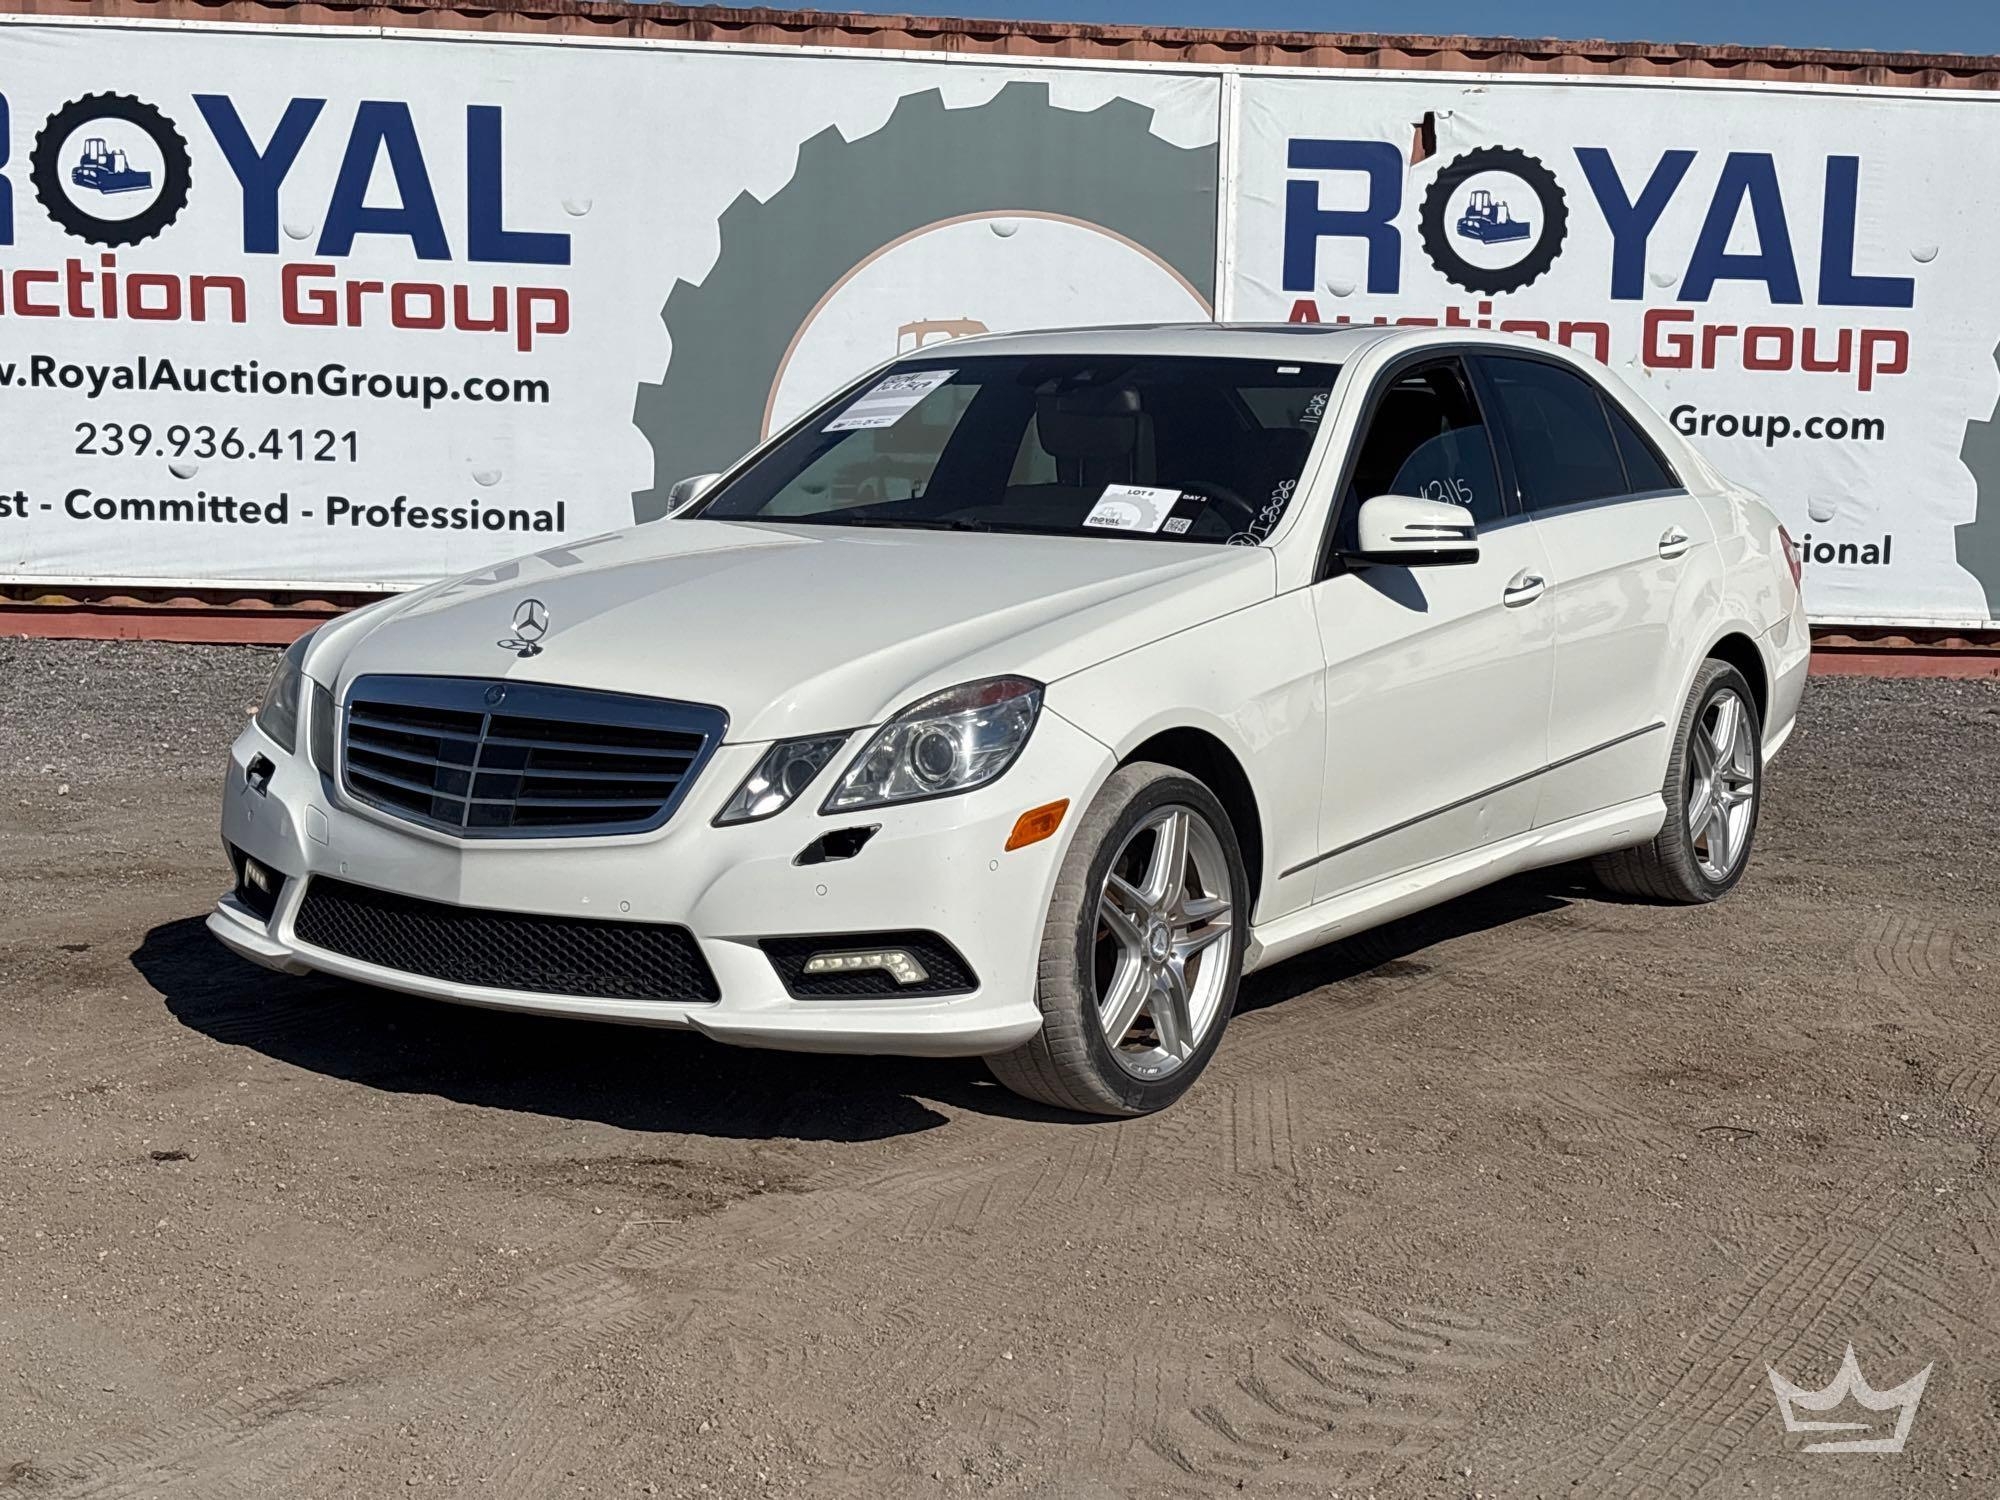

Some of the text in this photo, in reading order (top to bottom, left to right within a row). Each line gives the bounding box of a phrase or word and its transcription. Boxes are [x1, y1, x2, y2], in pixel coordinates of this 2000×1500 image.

[0, 90, 571, 265] OYAL
[1282, 138, 1915, 308] ROYAL
[0, 253, 570, 352] ction Group
[1642, 308, 1909, 391] Group
[74, 422, 358, 462] 239.936.4121
[64, 488, 289, 525] Committed
[326, 495, 566, 532] Professional
[1089, 516, 1120, 525] ROYAL
